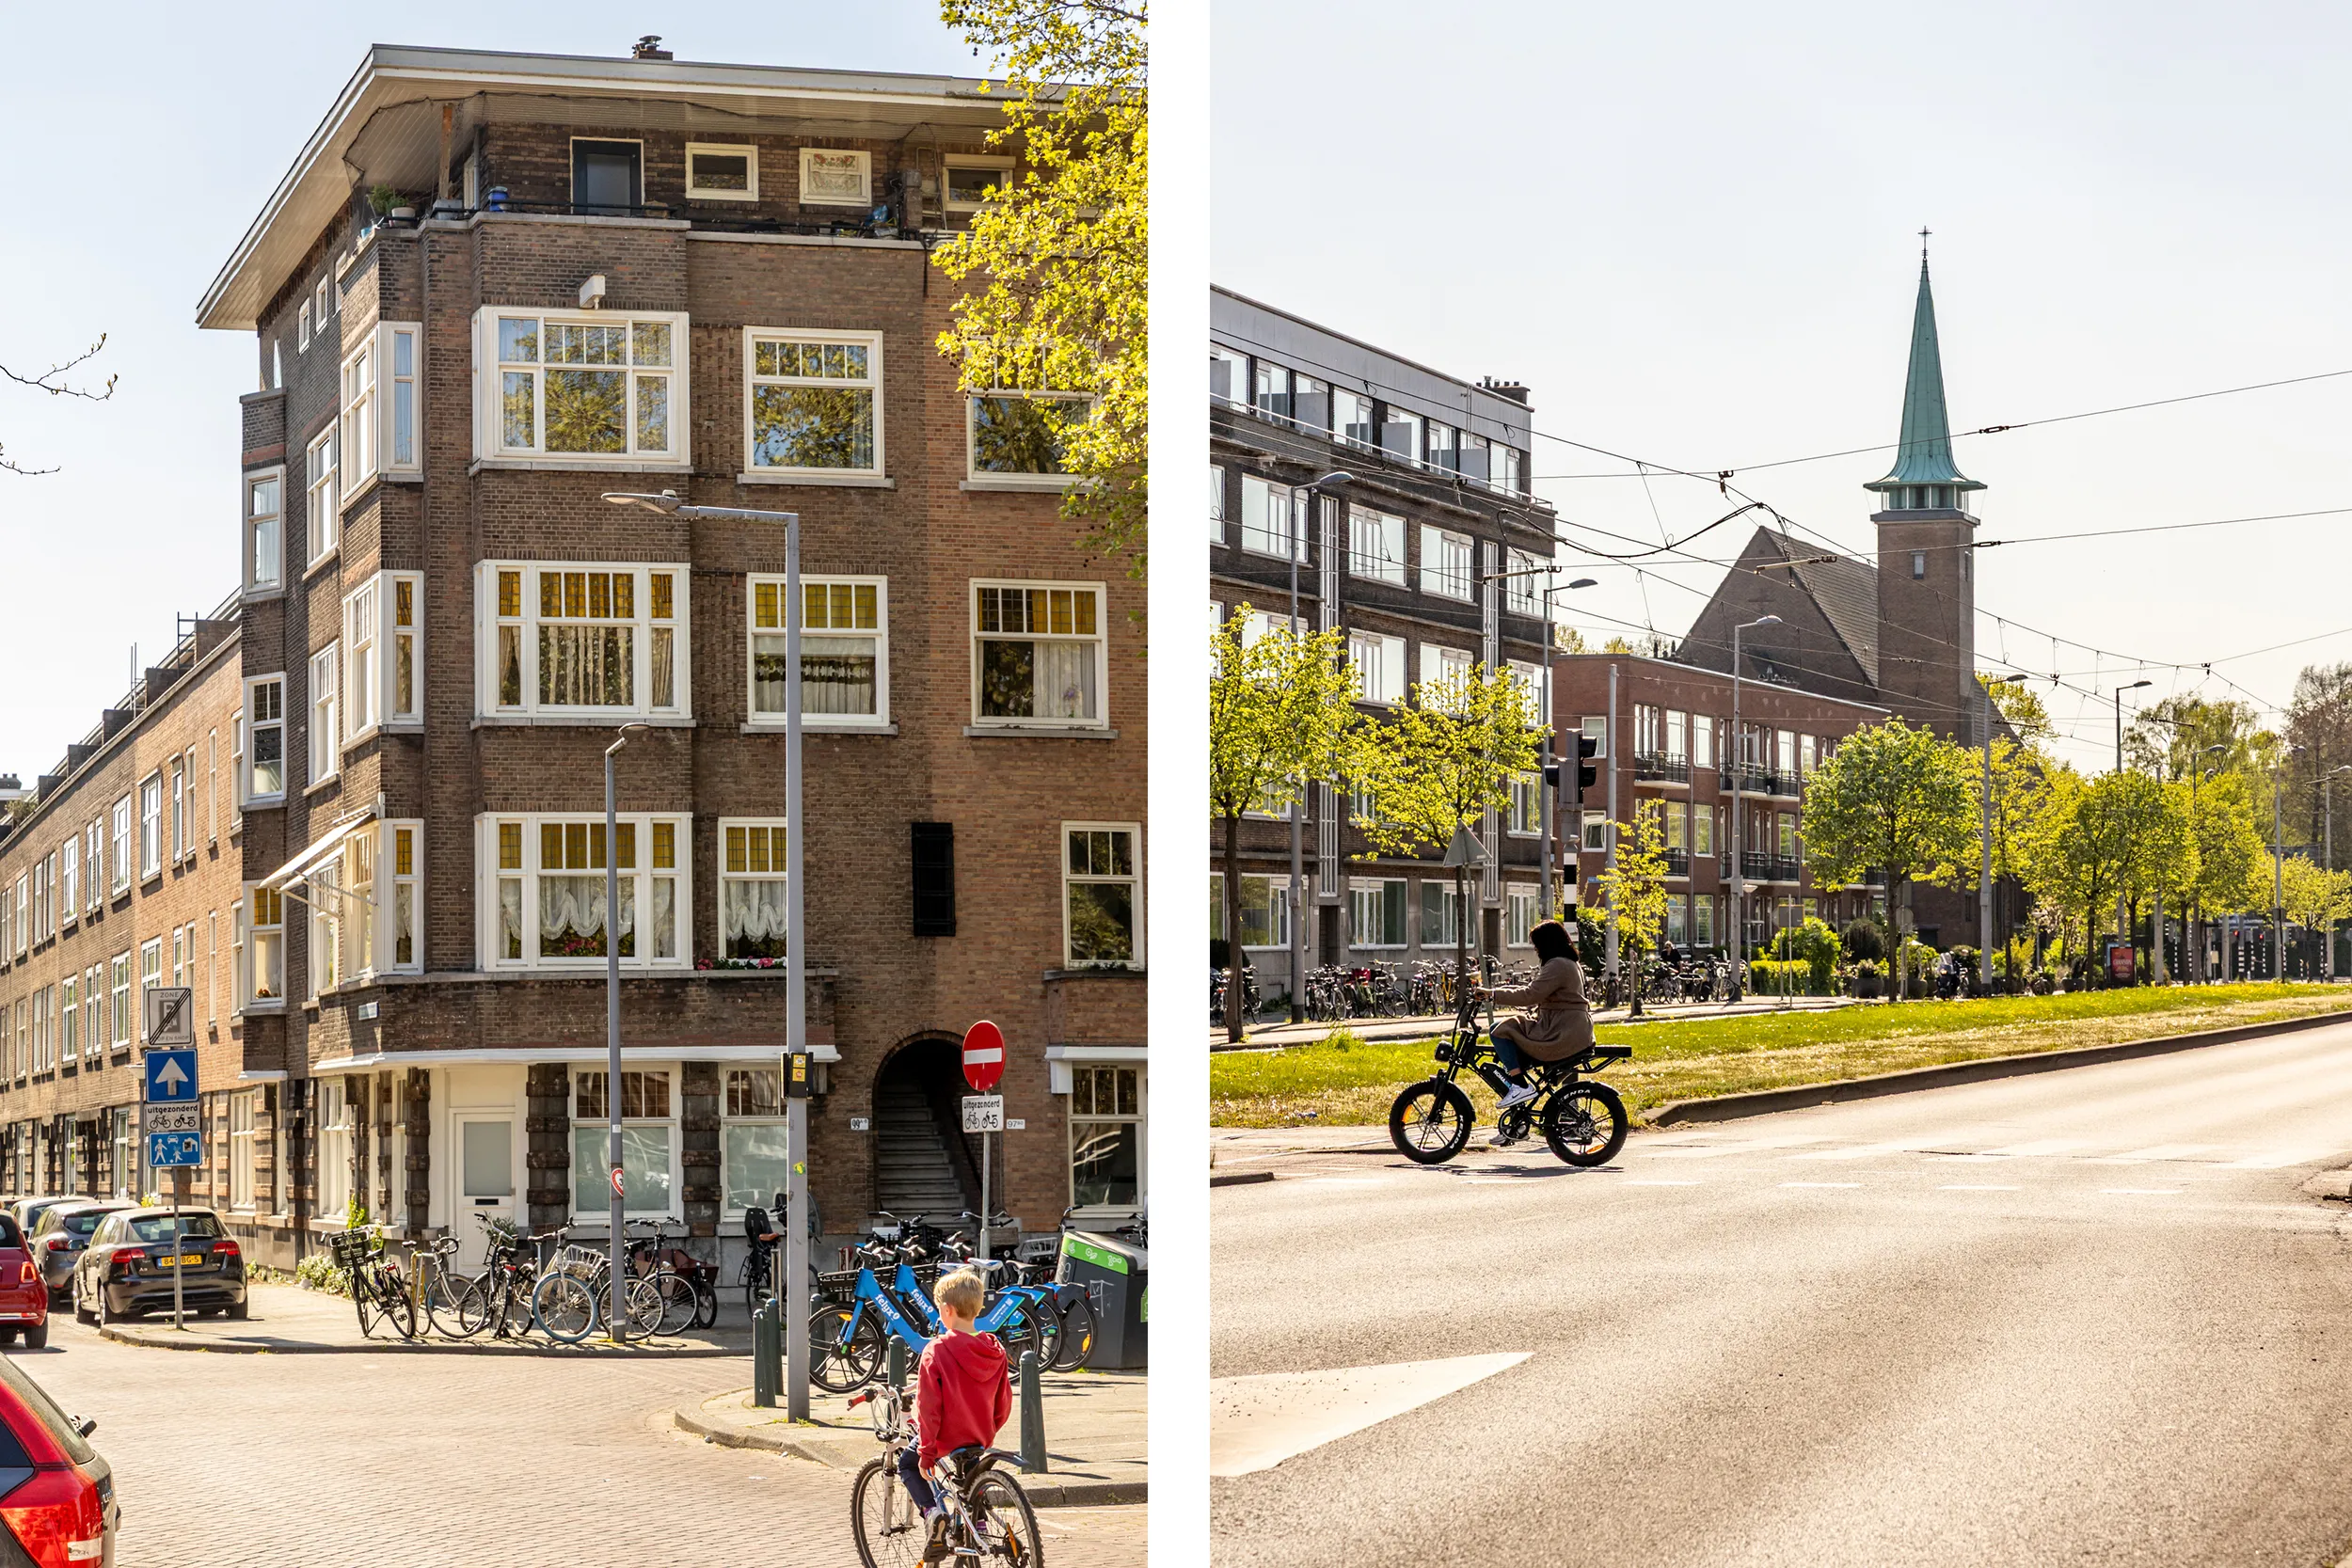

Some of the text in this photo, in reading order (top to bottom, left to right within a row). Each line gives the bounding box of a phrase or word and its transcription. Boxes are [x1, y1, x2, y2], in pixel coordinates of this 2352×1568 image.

[147, 1104, 198, 1115] uitgezonderd
[963, 1100, 1000, 1111] uitgezonderd
[1450, 1115, 1464, 1148] KENDA
[875, 1294, 895, 1317] felyx
[911, 1289, 929, 1310] felyx
